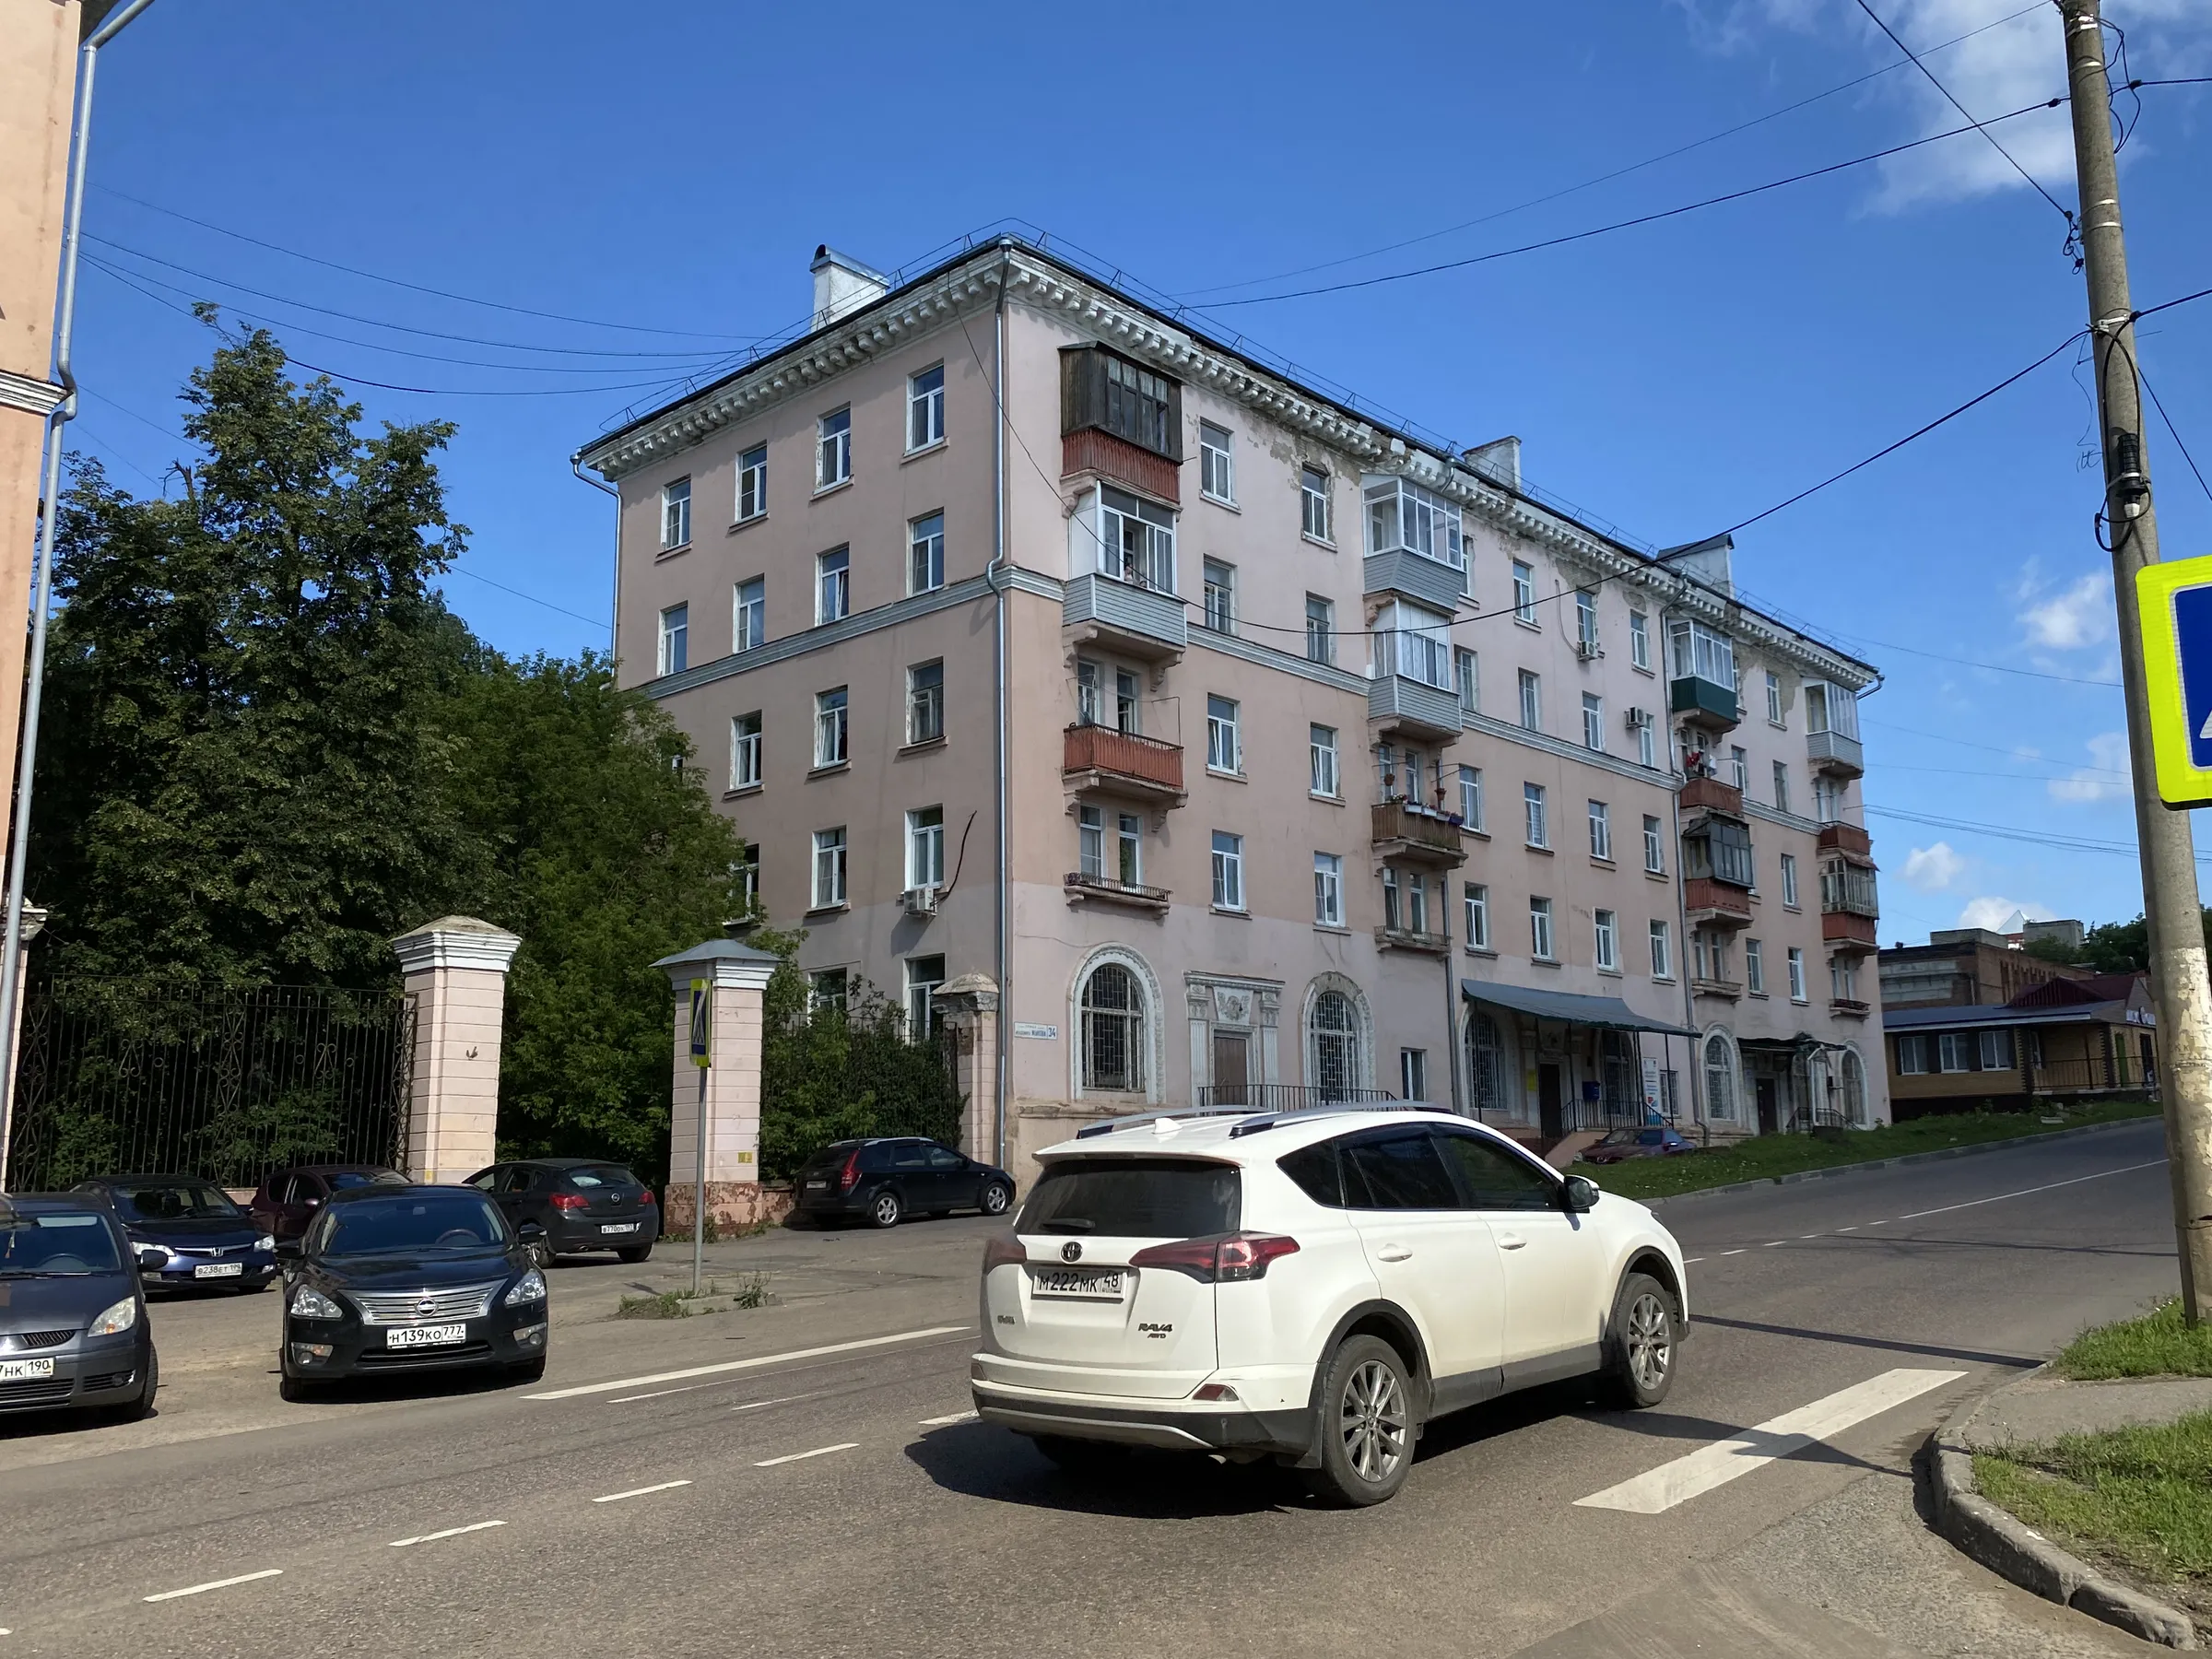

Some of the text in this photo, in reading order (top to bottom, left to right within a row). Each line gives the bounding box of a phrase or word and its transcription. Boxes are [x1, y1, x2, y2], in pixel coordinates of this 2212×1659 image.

[1048, 1027, 1056, 1038] 34
[1039, 1270, 1119, 1293] М222МК 48
[392, 1325, 462, 1343] Н139КО 777
[1137, 1323, 1173, 1333] RAV4
[28, 1359, 50, 1371] 190
